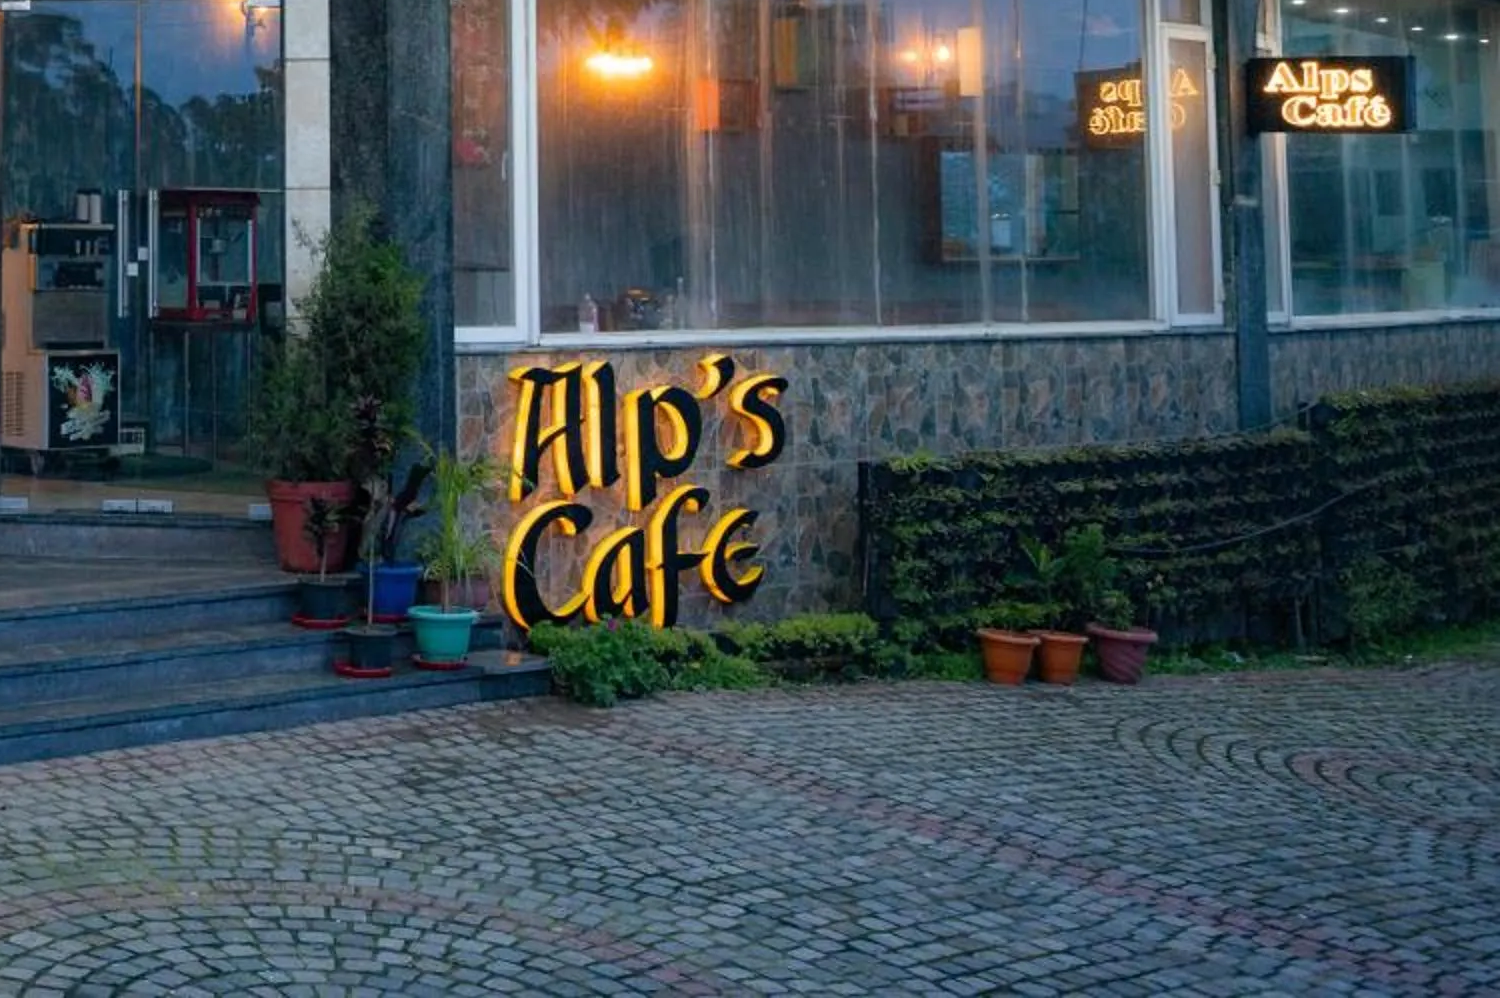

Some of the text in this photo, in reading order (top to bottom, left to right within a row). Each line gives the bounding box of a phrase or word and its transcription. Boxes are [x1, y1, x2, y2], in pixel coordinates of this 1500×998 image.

[1263, 60, 1373, 100] Alps
[1281, 95, 1392, 128] Café
[507, 353, 790, 513] Alp's
[502, 483, 766, 633] Cafe
